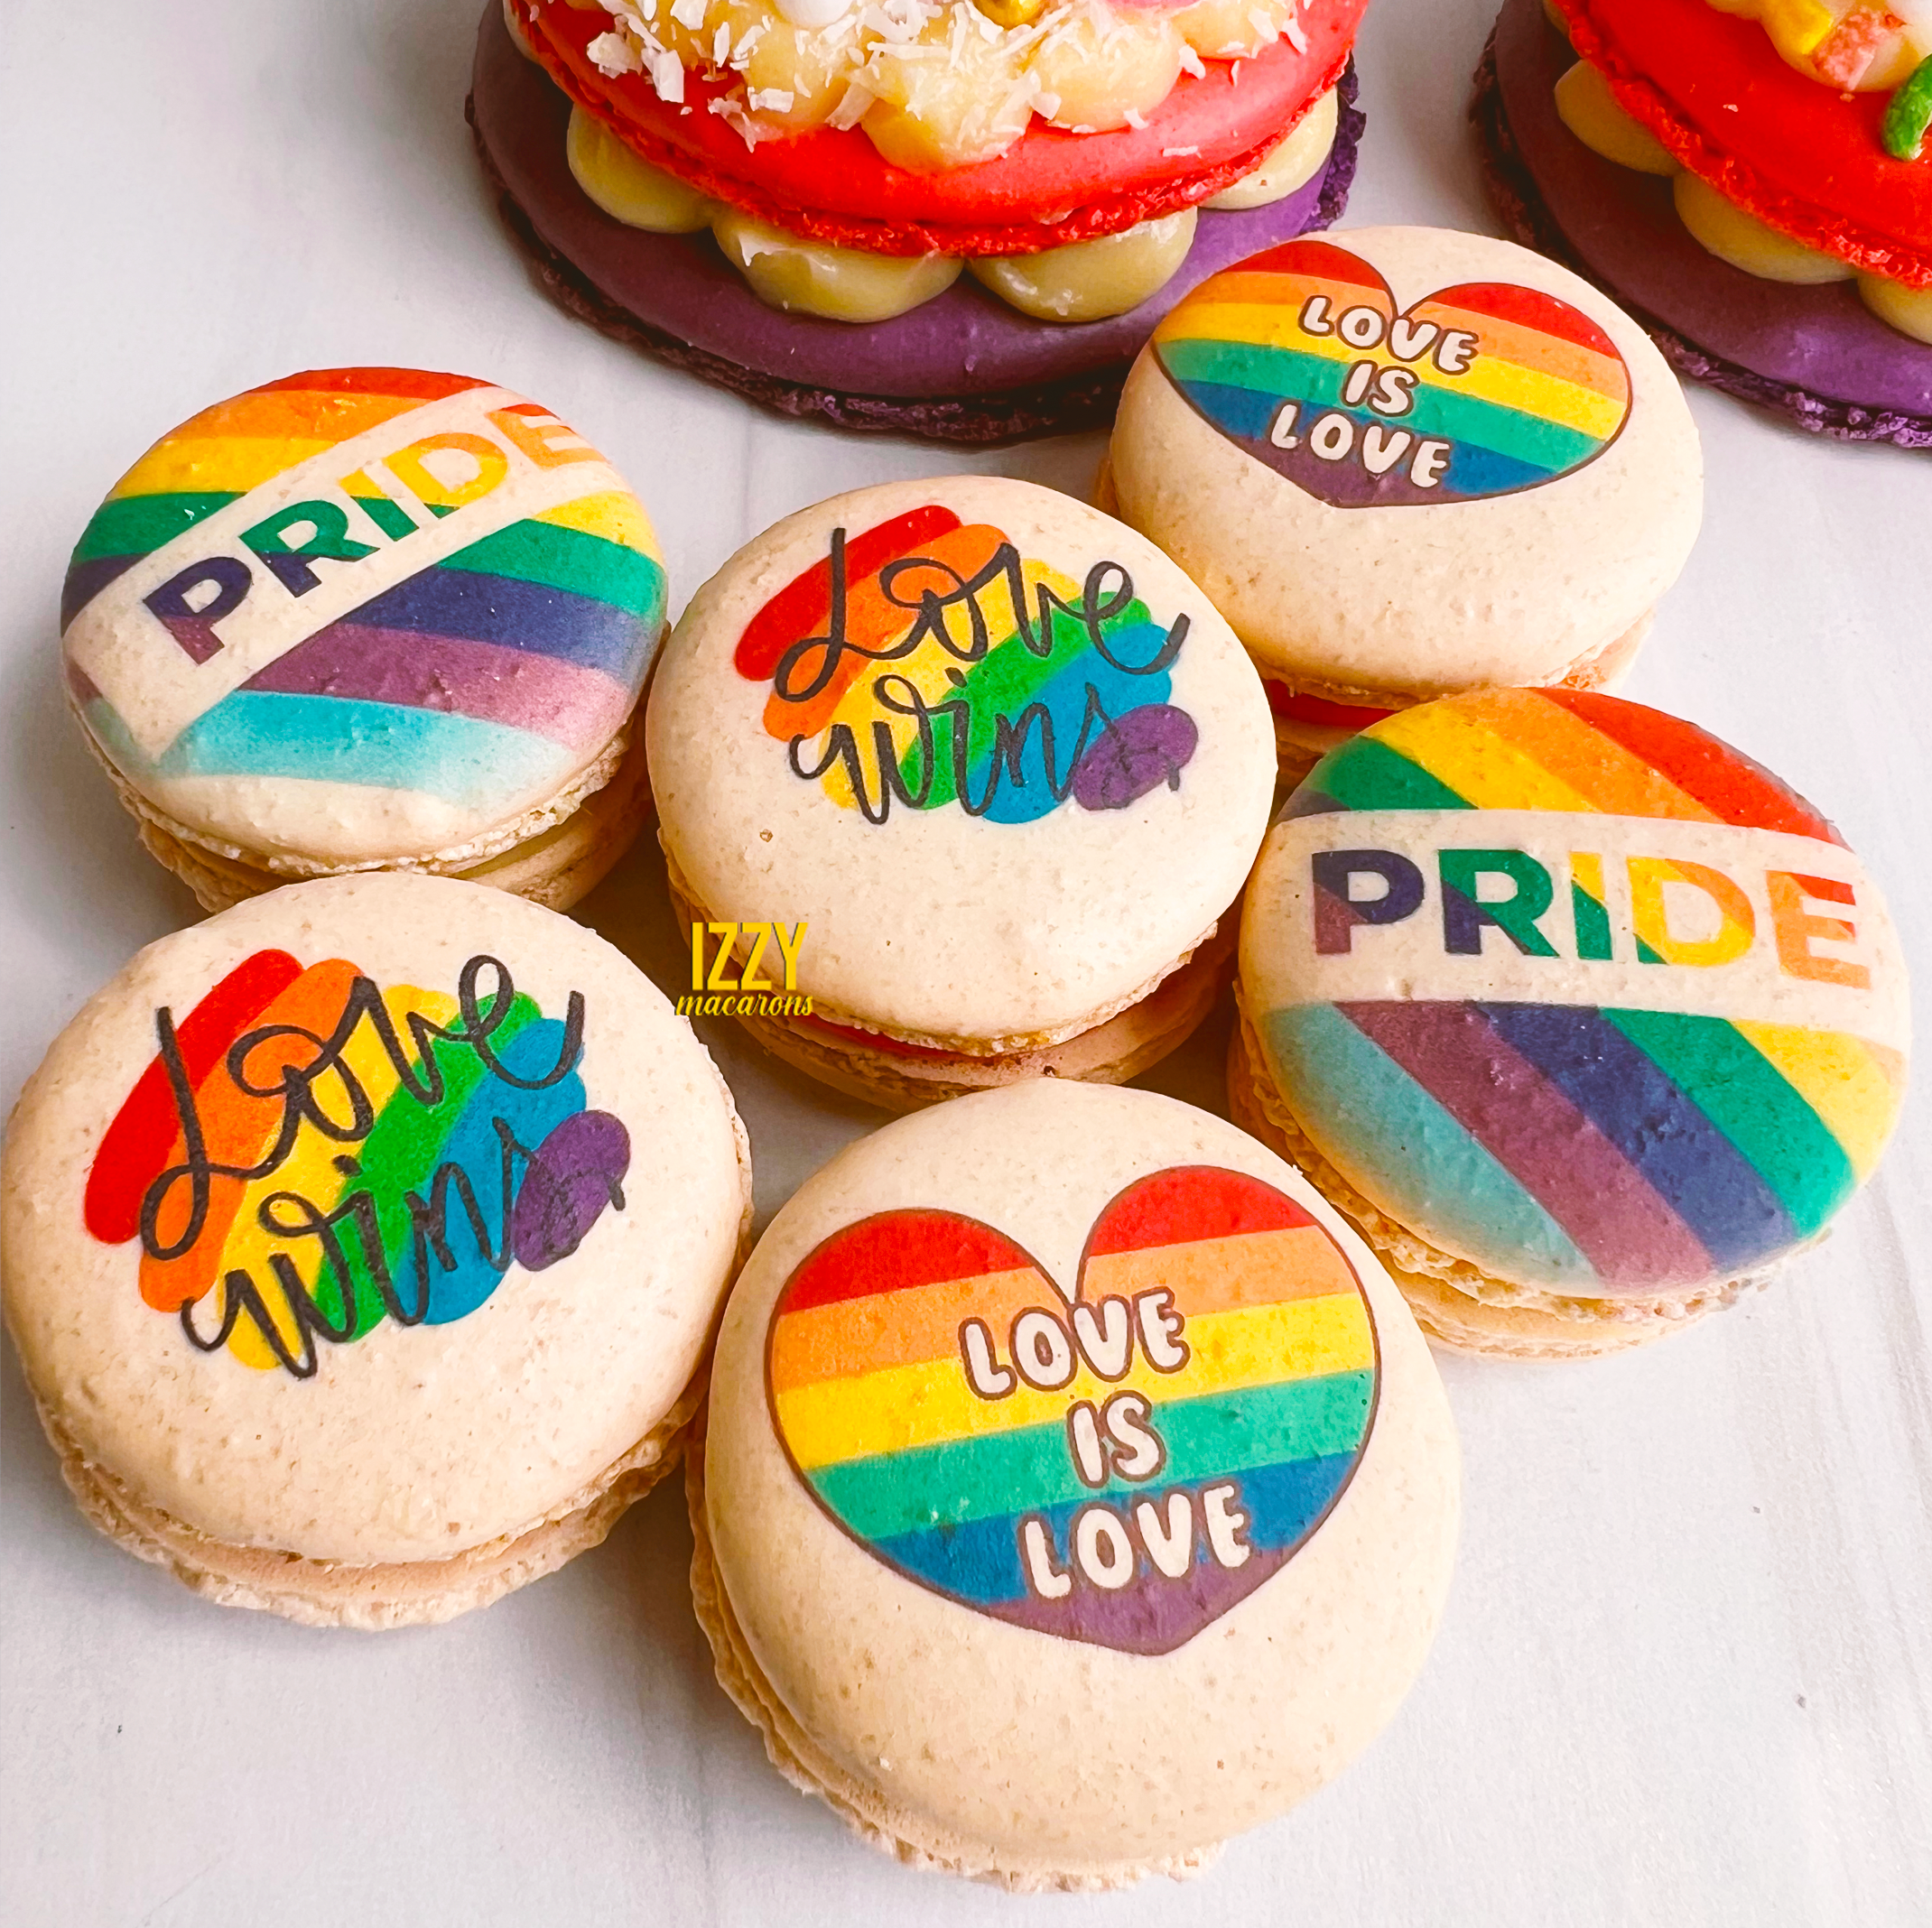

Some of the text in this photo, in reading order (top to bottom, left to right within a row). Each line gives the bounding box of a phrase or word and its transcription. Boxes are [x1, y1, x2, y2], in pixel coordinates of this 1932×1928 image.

[1298, 295, 1479, 375] LOVE
[1340, 360, 1420, 416] IS
[1269, 403, 1450, 489] LOVE
[143, 403, 612, 664] PRIDE
[775, 527, 1190, 701] Love
[790, 669, 1179, 824] wins
[1312, 849, 1871, 989] PRIDE
[139, 955, 585, 1260] Love
[181, 1117, 626, 1379] wins
[958, 1286, 1190, 1400] LOVE
[1067, 1390, 1166, 1488] IS
[1020, 1481, 1251, 1599] LOVE
